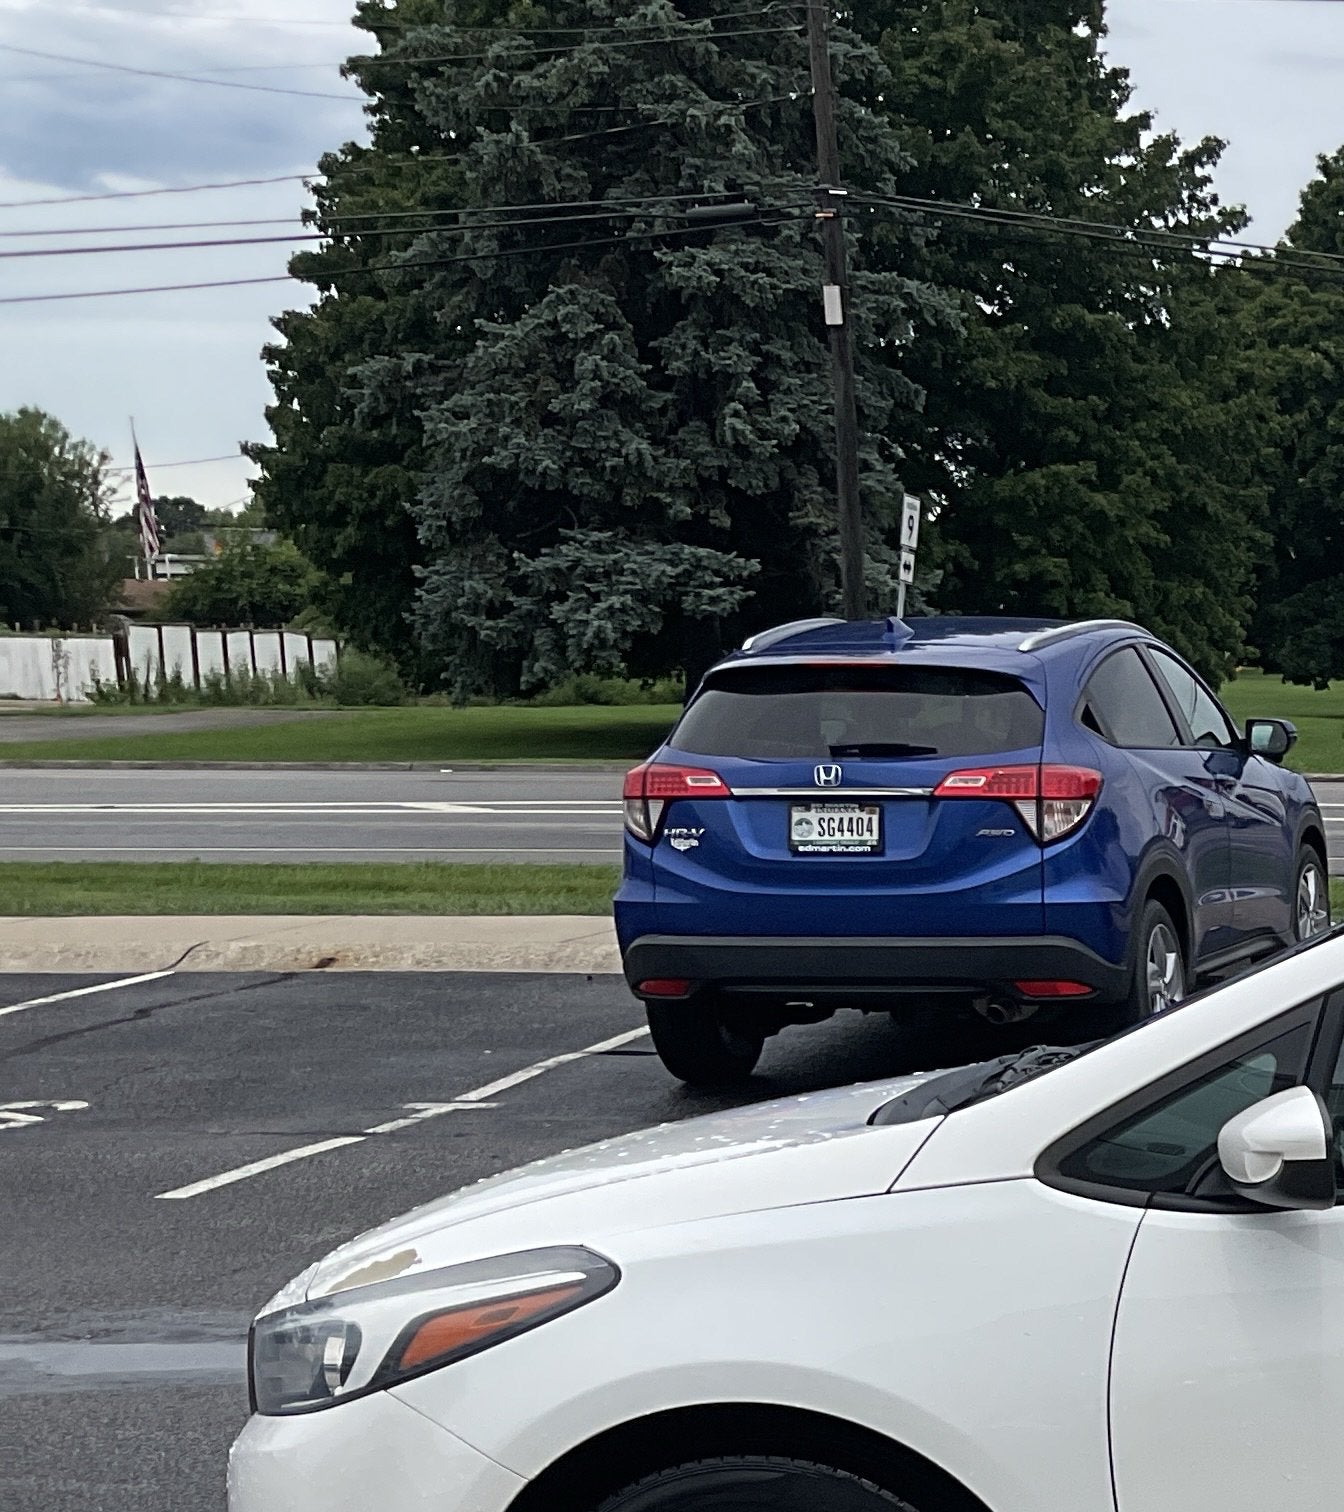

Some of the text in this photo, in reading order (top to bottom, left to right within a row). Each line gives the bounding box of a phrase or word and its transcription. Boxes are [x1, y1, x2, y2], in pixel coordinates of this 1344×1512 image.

[908, 515, 914, 542] 9
[664, 827, 706, 838] HR-V
[817, 817, 874, 837] SG4404
[797, 844, 872, 853] edmartin.com
